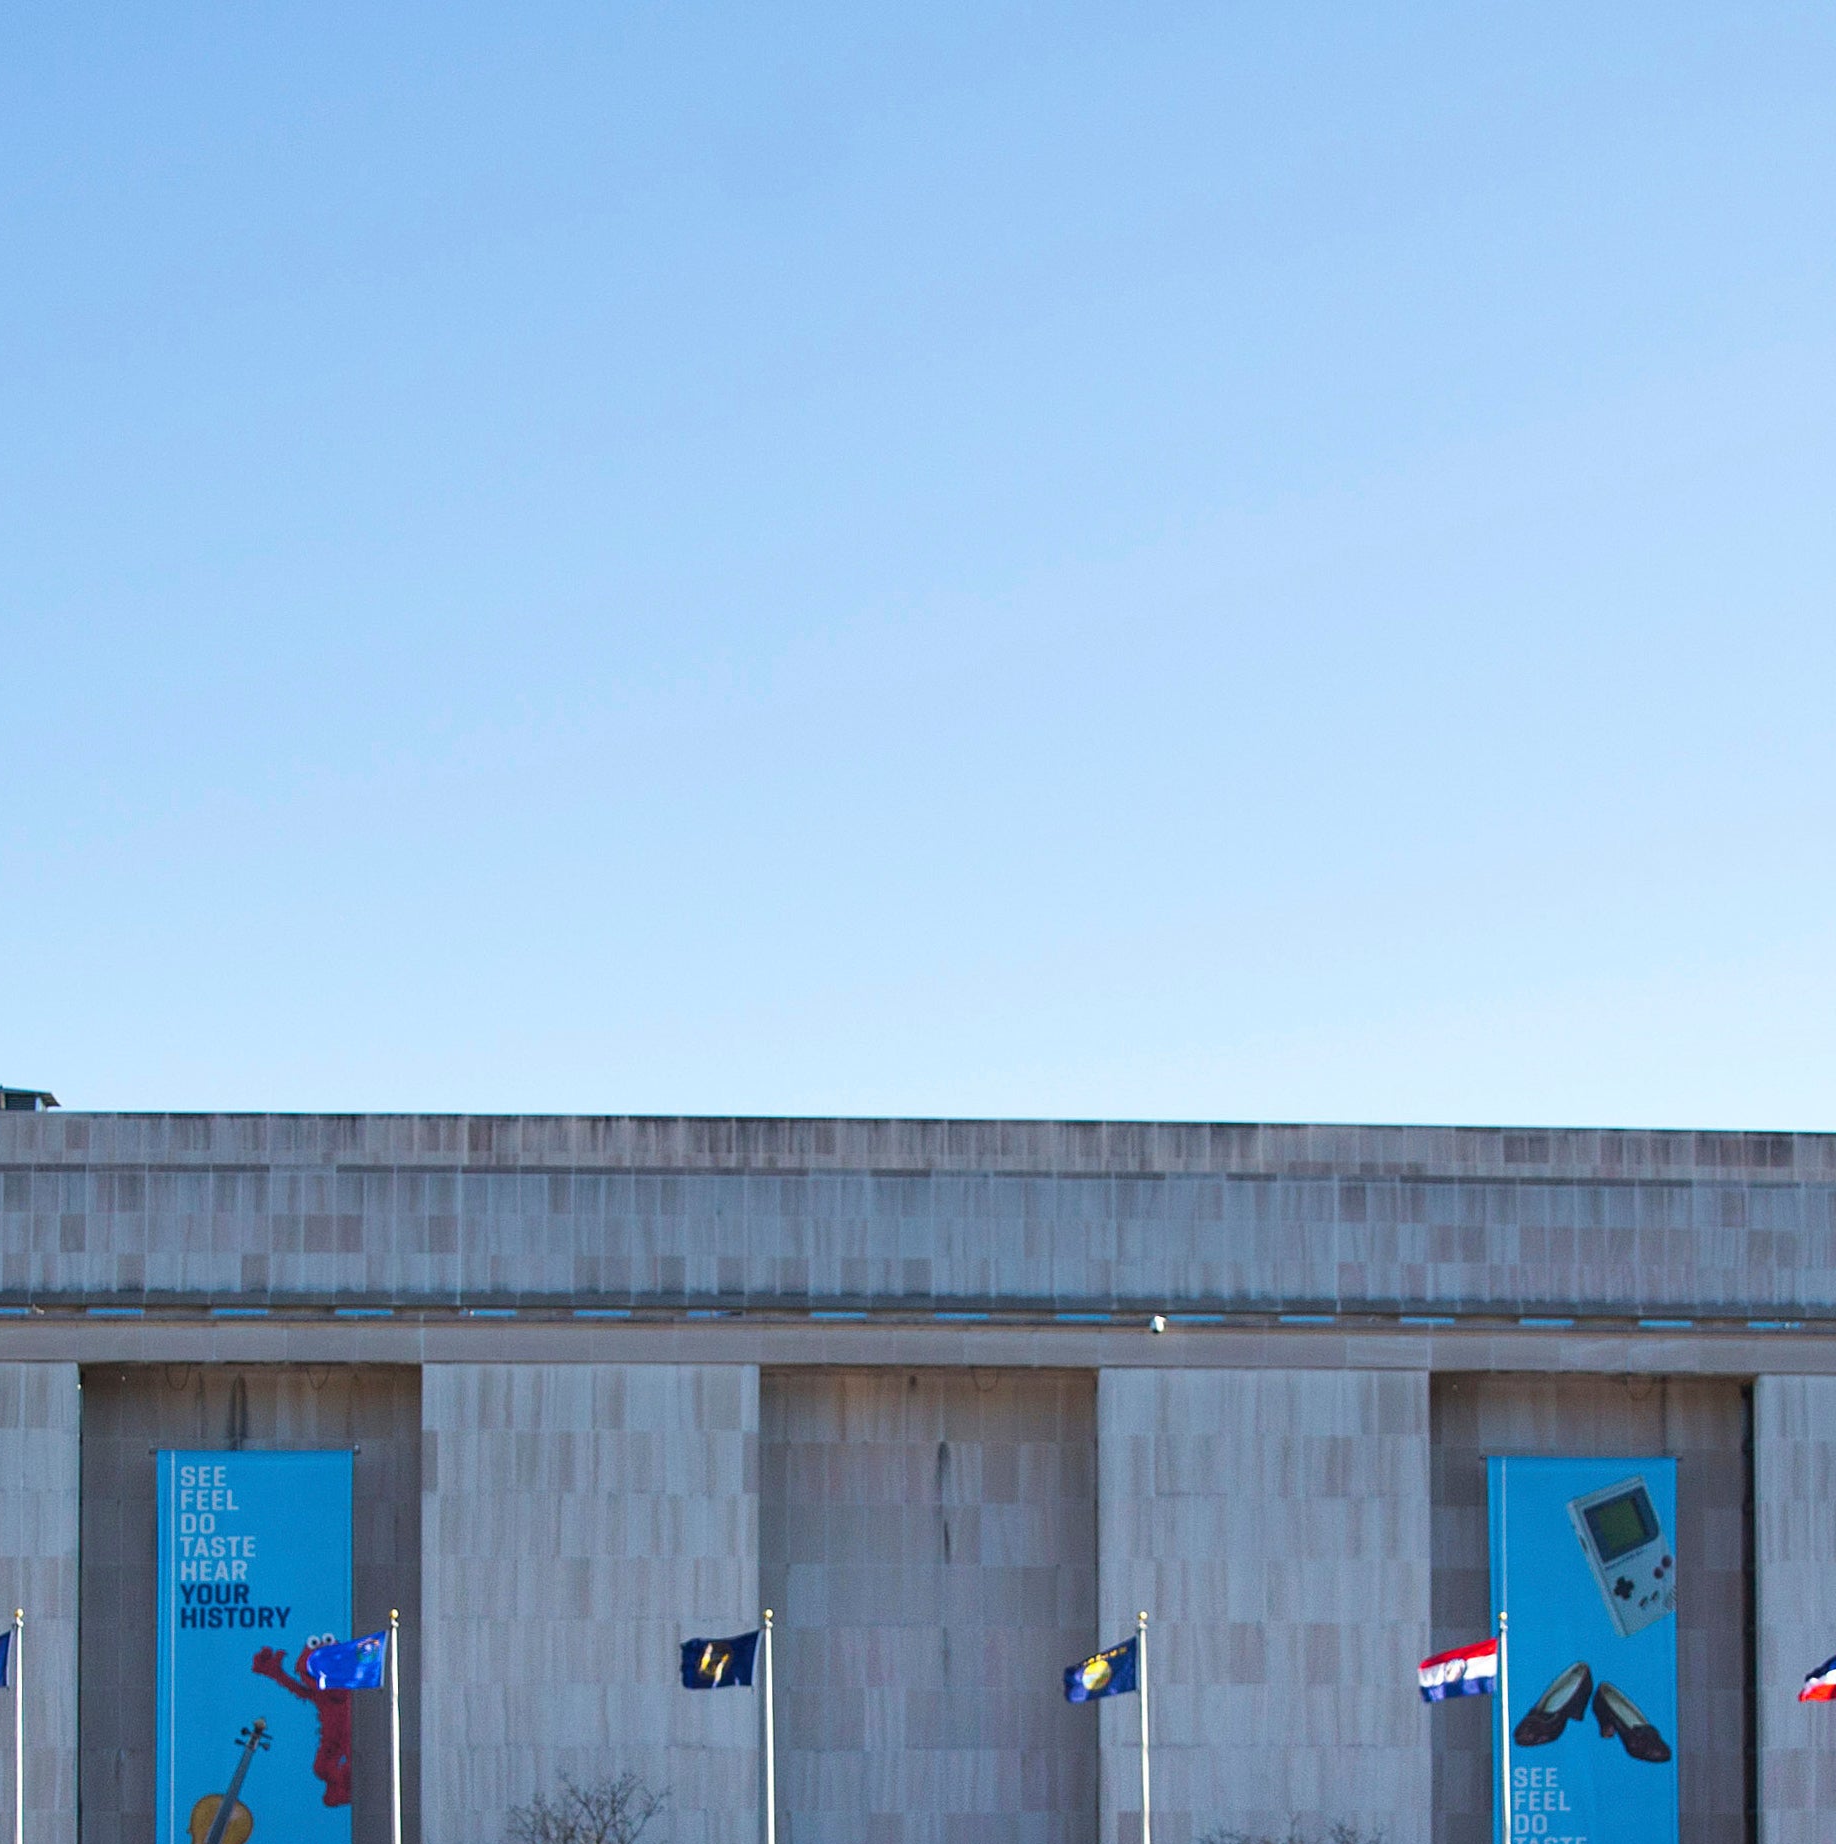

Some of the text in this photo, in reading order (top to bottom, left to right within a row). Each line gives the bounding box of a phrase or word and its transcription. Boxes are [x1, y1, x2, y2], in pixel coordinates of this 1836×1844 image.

[180, 1465, 226, 1487] SEE
[180, 1489, 239, 1511] FEEL
[181, 1513, 215, 1534] DO
[180, 1536, 256, 1558] TASTE
[180, 1560, 248, 1581] HEAR
[180, 1583, 250, 1605] YOUR
[180, 1606, 291, 1629] HISTORY
[1514, 1767, 1558, 1788] SEE
[1514, 1791, 1571, 1811] FEEL
[1514, 1814, 1548, 1834] DO
